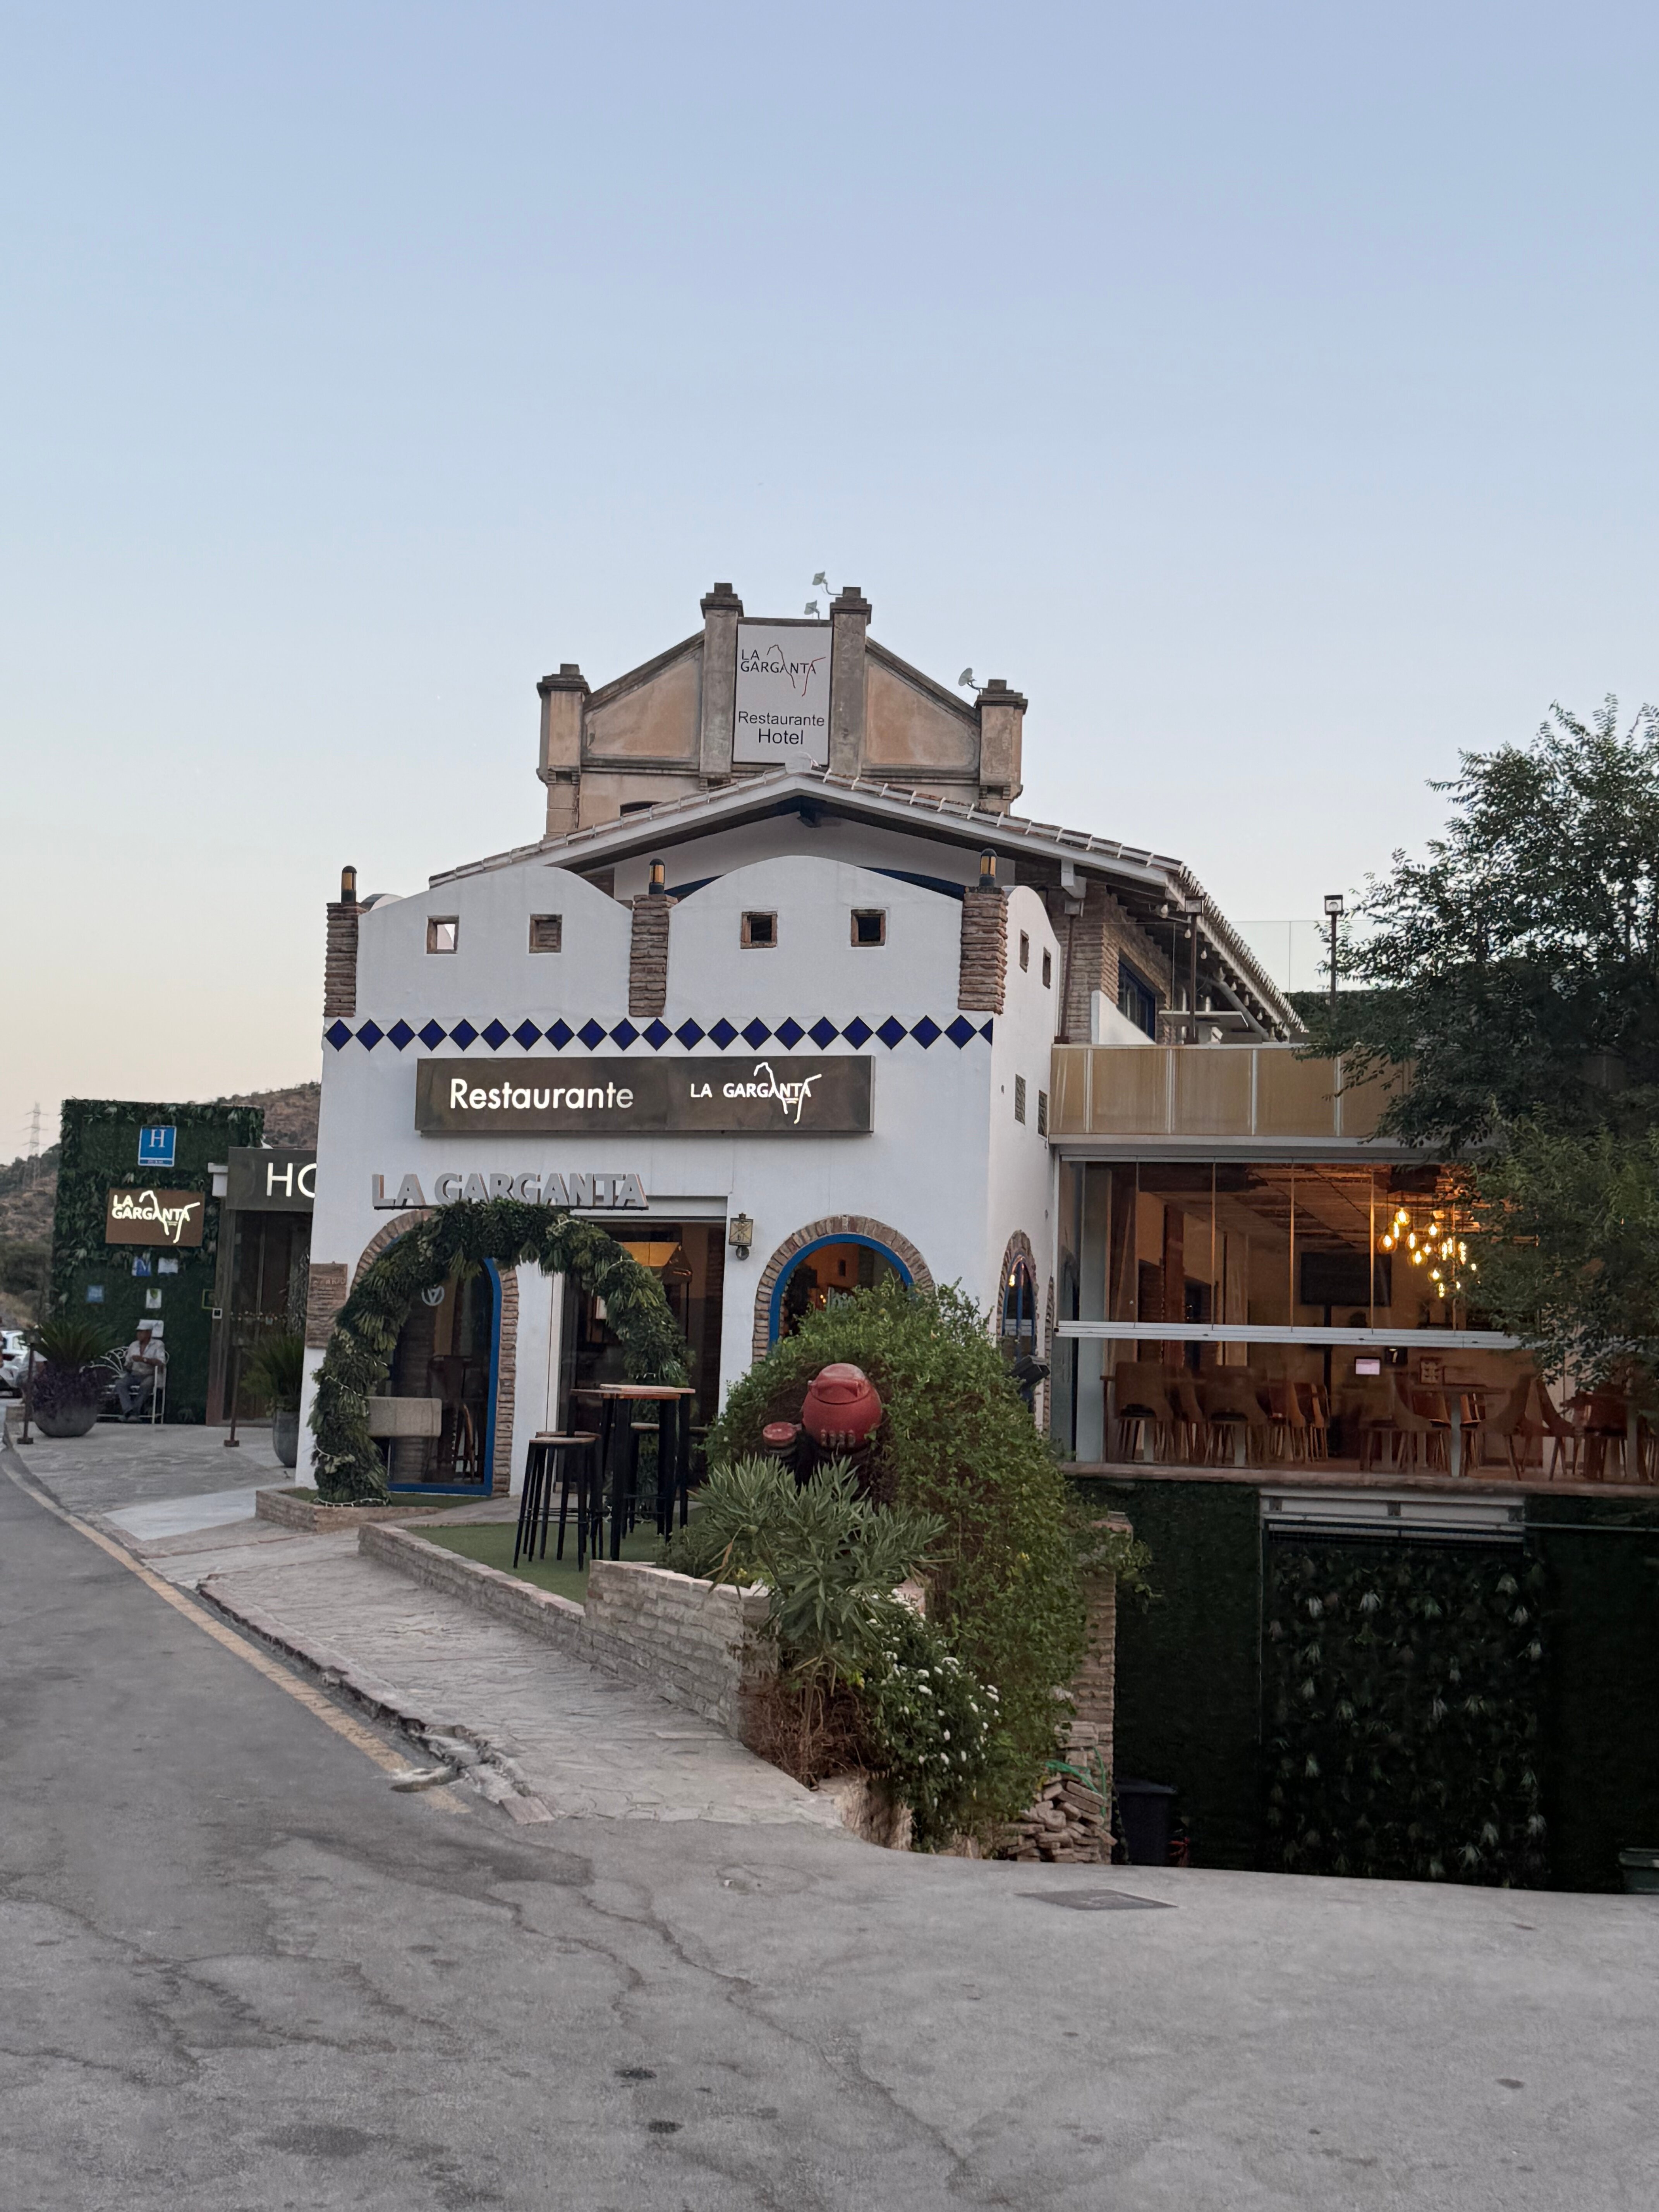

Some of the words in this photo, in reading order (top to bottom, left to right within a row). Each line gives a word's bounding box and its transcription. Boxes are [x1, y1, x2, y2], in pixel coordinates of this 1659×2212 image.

[742, 649, 760, 661] LA
[740, 661, 817, 675] GARGANTA
[738, 711, 825, 726] Restaurante
[759, 728, 804, 745] Hotel
[450, 1078, 634, 1109] Restaurante
[690, 1083, 713, 1098] LA
[723, 1083, 811, 1098] GARGANTA
[149, 1129, 167, 1148] H
[372, 1174, 426, 1207] LA
[434, 1173, 648, 1207] GARGANTA
[113, 1195, 134, 1208] LA
[112, 1206, 190, 1221] GARGANTA
